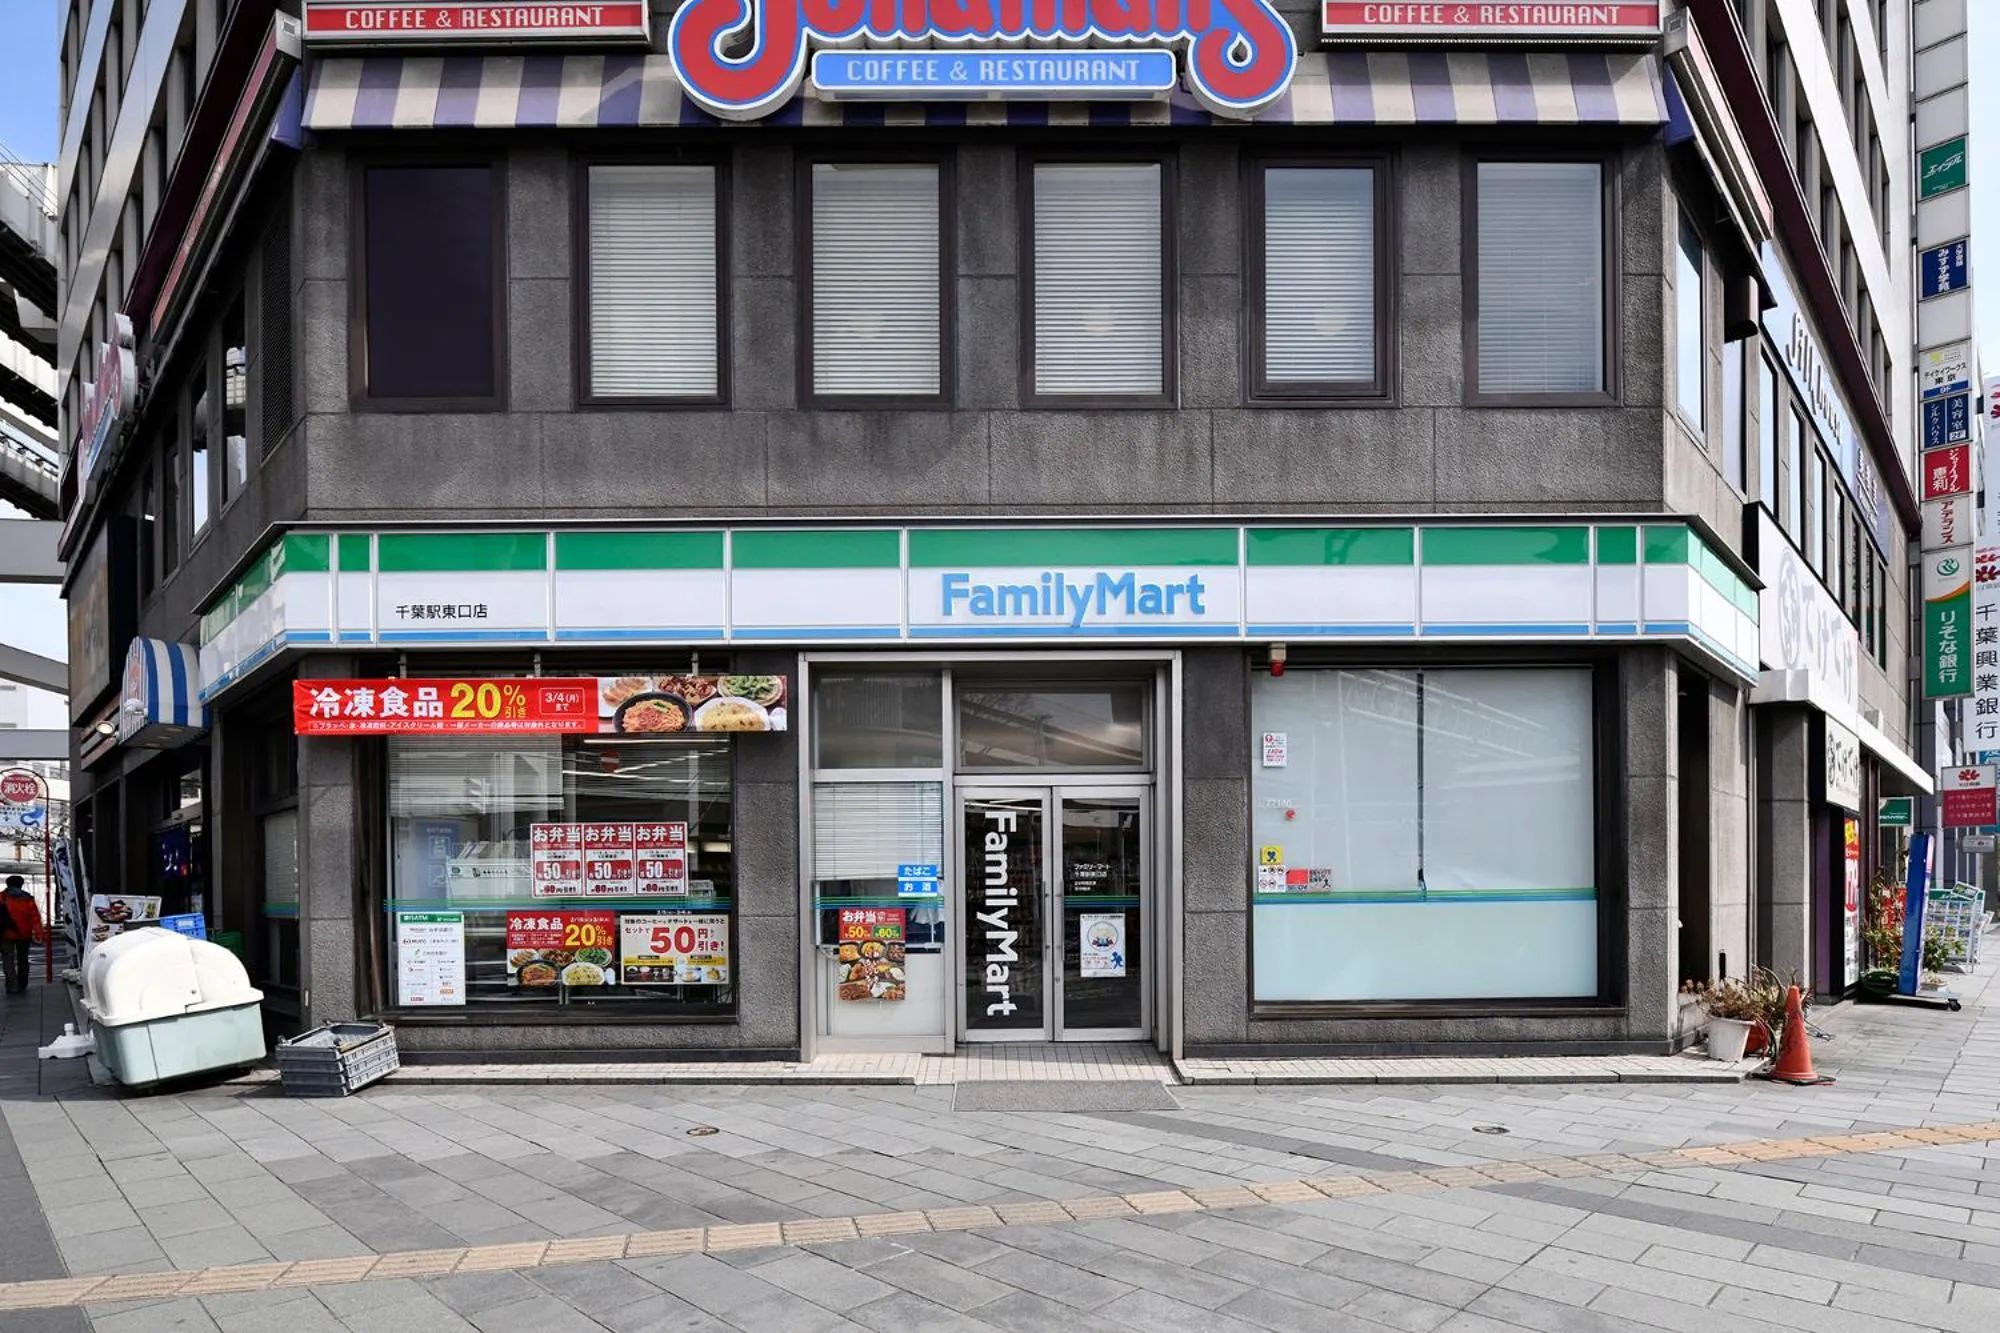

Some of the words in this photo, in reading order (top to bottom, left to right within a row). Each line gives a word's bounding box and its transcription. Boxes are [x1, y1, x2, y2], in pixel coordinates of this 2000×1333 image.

[345, 9, 426, 29] COFFEE
[435, 10, 452, 28] &
[461, 7, 604, 28] RESTAURANT
[1363, 5, 1444, 24] COFFEE
[1453, 6, 1470, 24] &
[1480, 5, 1621, 24] RESTAURANT
[848, 60, 939, 81] COFFEE
[949, 60, 968, 81] &
[979, 60, 1141, 81] RESTAURANT
[1941, 500, 1955, 545] アデランス
[942, 572, 1206, 628] FamilyMart
[395, 603, 488, 620] 千葉駅東口店
[1938, 610, 1958, 684] りそな銀行
[1975, 603, 1999, 740] 千葉興業銀行
[309, 687, 444, 719] 冷凍食品
[450, 682, 526, 719] 20%
[504, 706, 527, 719] 引き
[554, 703, 569, 712] まで
[534, 826, 580, 843] お弁当
[585, 826, 632, 843] お弁当
[636, 825, 684, 842] お弁当
[904, 866, 931, 876] たばこ
[842, 910, 877, 924] お弁当
[976, 811, 1019, 1016] FamilyMart
[509, 917, 563, 931] 冷凍食品
[564, 924, 606, 946] 20%
[624, 926, 650, 935] セットで
[650, 926, 696, 954] 50
